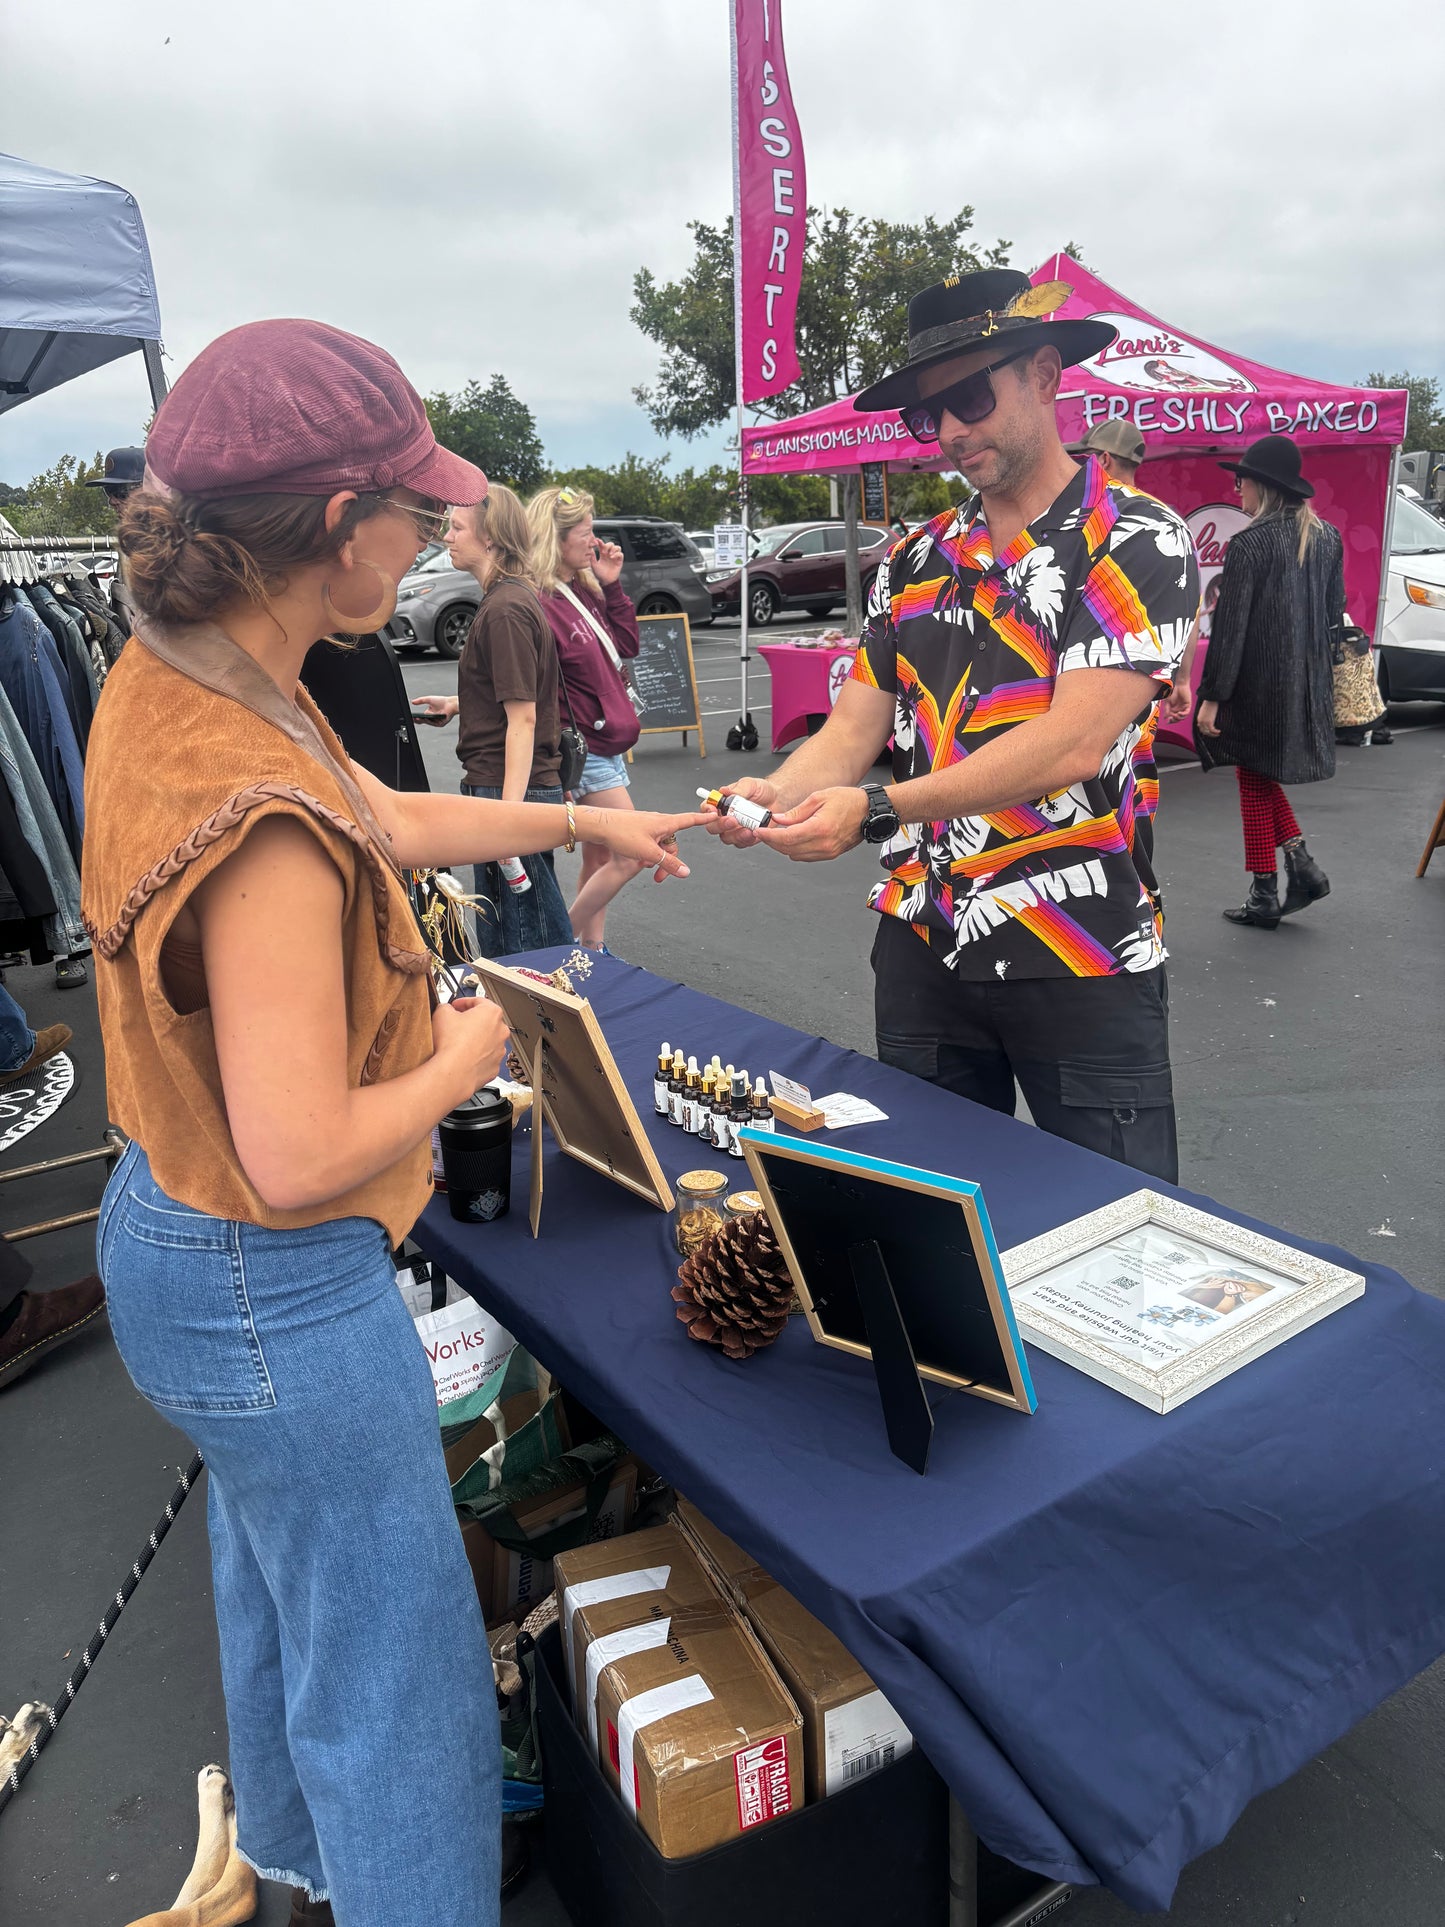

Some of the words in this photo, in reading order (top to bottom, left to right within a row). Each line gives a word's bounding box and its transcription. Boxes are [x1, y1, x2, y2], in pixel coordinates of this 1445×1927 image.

[759, 0, 794, 382] SSERTS
[1083, 395, 1251, 434] FRESHLY
[1266, 400, 1379, 434] BAKED
[1032, 1291, 1056, 1303] start
[1039, 1285, 1071, 1301] today!
[1056, 1303, 1078, 1314] and
[1071, 1300, 1113, 1321] journey
[1079, 1313, 1118, 1335] website
[1112, 1319, 1153, 1341] healing
[1120, 1334, 1139, 1344] our
[1152, 1339, 1180, 1353] your
[1141, 1343, 1164, 1358] Visit
[667, 1637, 689, 1664] CHINA
[770, 1760, 789, 1815] FRAGILE
